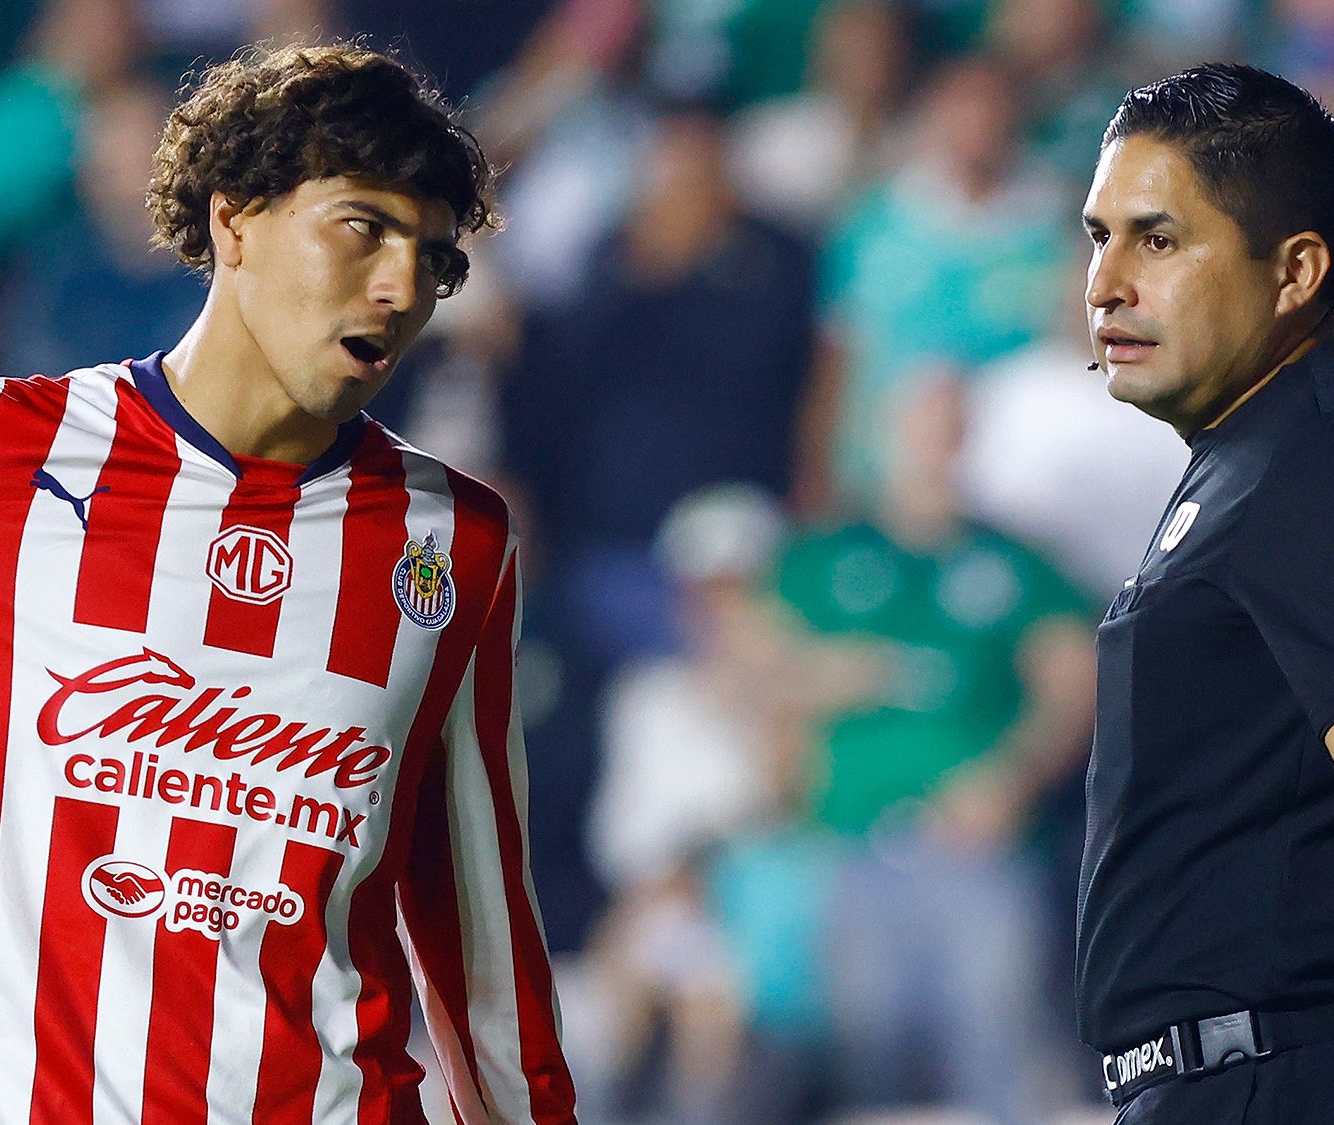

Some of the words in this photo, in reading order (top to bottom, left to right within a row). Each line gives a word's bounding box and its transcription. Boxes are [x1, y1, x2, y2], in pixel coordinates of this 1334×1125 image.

[212, 533, 285, 597] MG
[36, 646, 391, 789] Caliente
[64, 751, 367, 848] caliente.mx
[172, 899, 240, 931] pago
[176, 873, 298, 919] mercado
